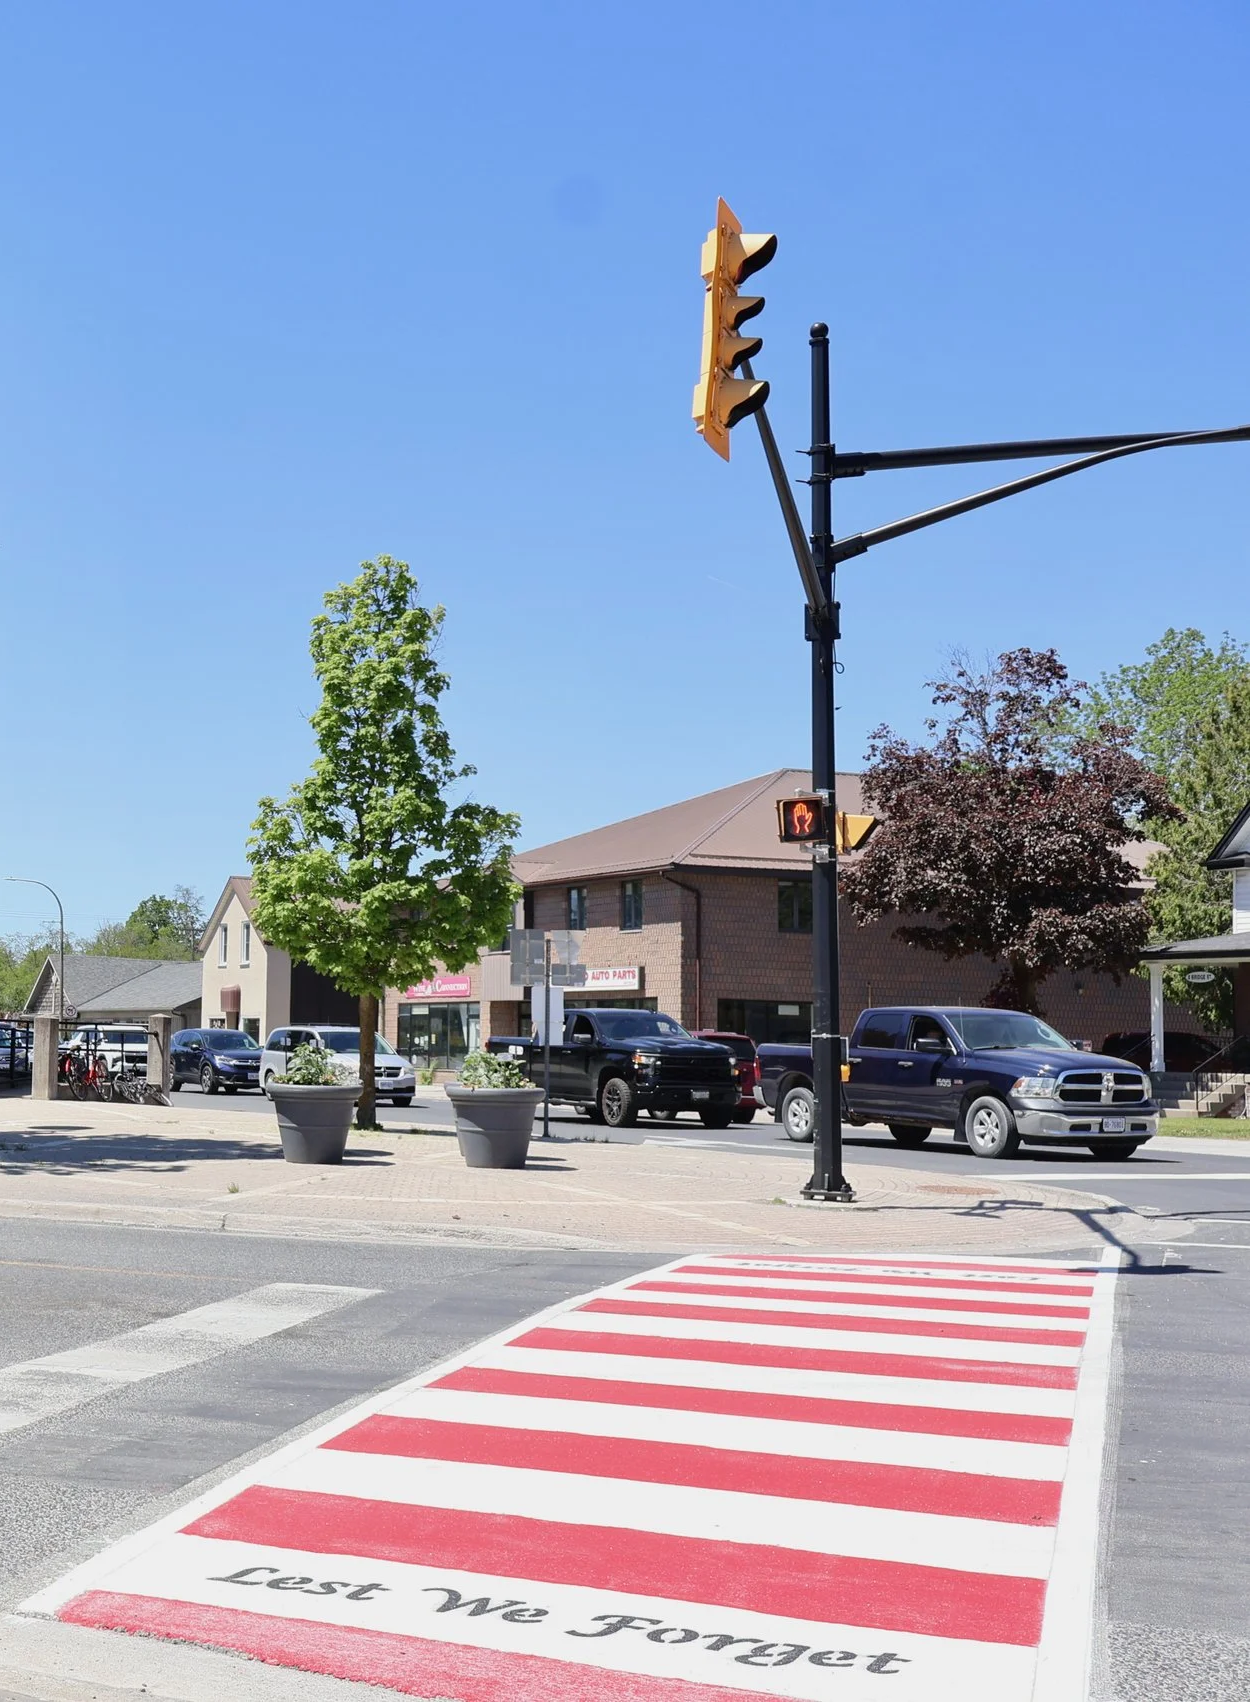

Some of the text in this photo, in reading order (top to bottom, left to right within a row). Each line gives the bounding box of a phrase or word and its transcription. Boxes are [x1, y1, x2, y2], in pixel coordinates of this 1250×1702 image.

[591, 971, 610, 981] AUTO
[612, 969, 637, 980] PARTS
[206, 1566, 912, 1675] Lest We Forget
